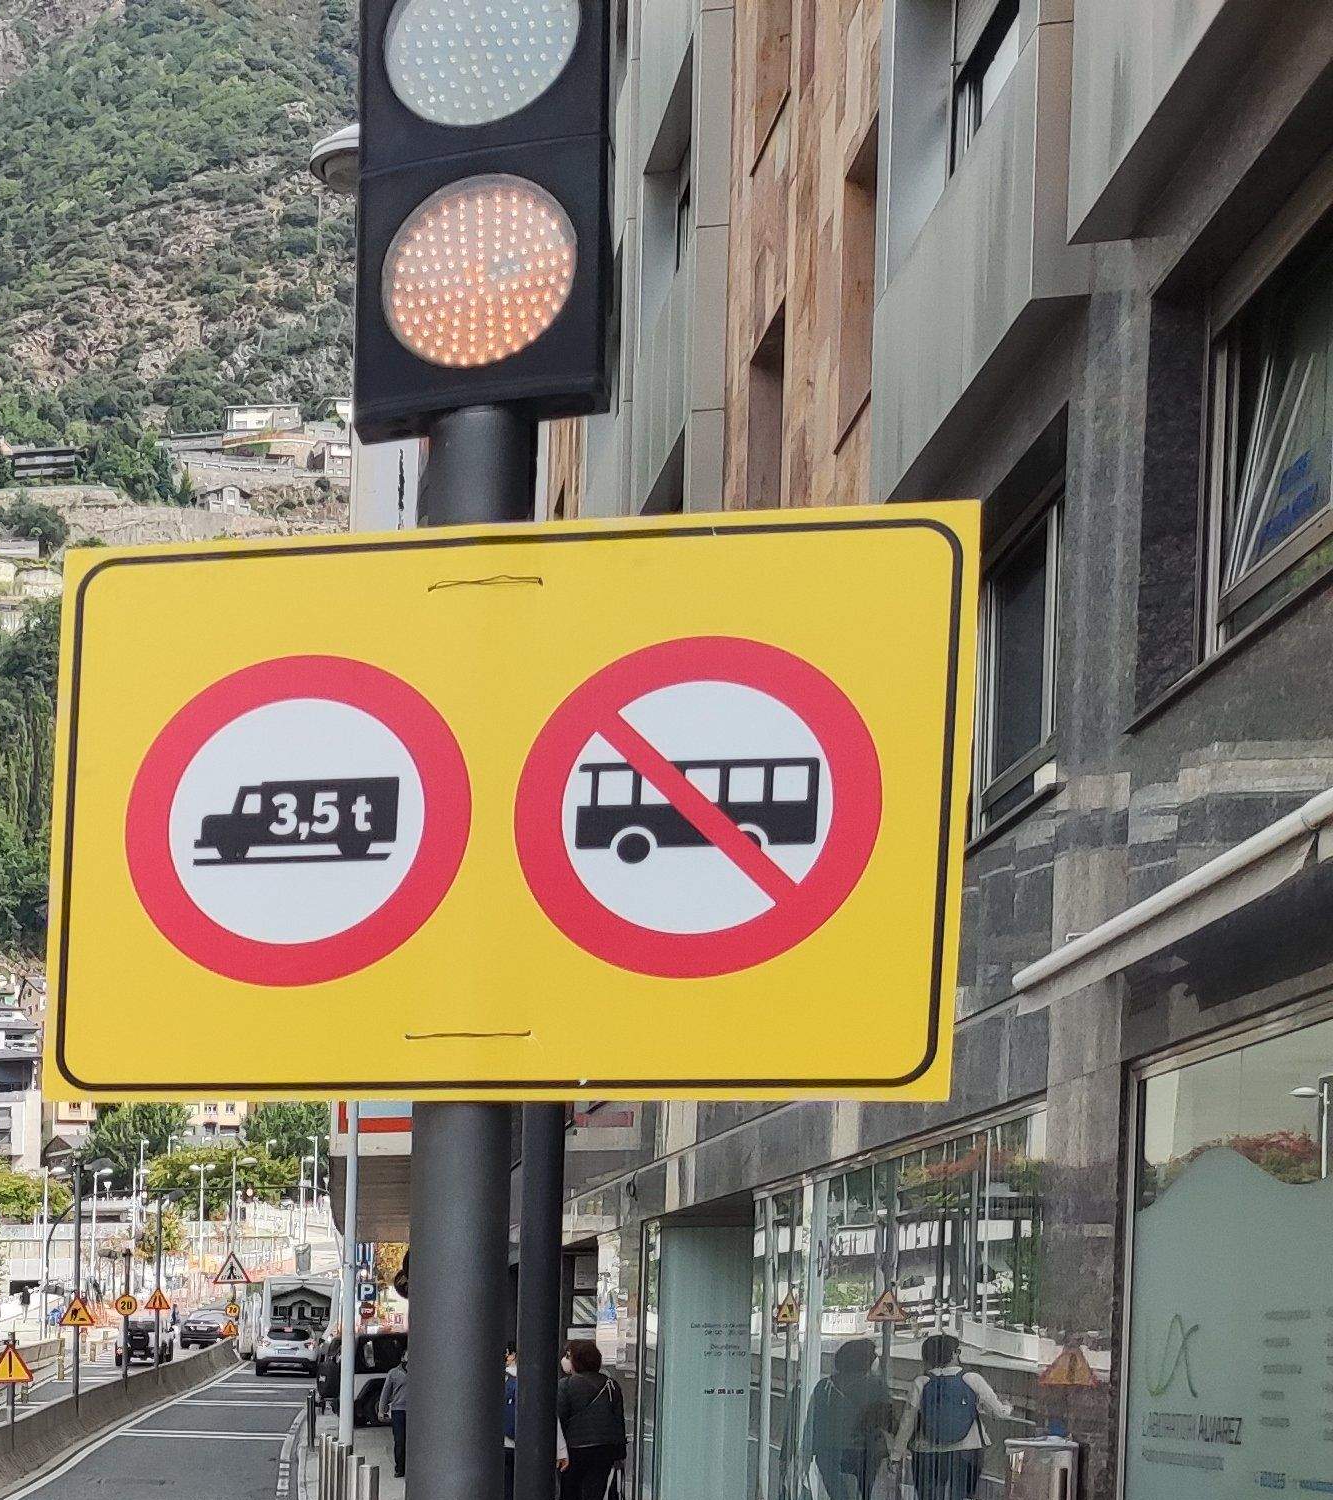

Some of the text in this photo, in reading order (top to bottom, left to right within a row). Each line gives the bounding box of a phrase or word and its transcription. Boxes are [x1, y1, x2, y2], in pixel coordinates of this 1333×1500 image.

[269, 791, 372, 841] 3,5 t
[360, 1283, 374, 1300] P
[120, 1300, 133, 1311] 20
